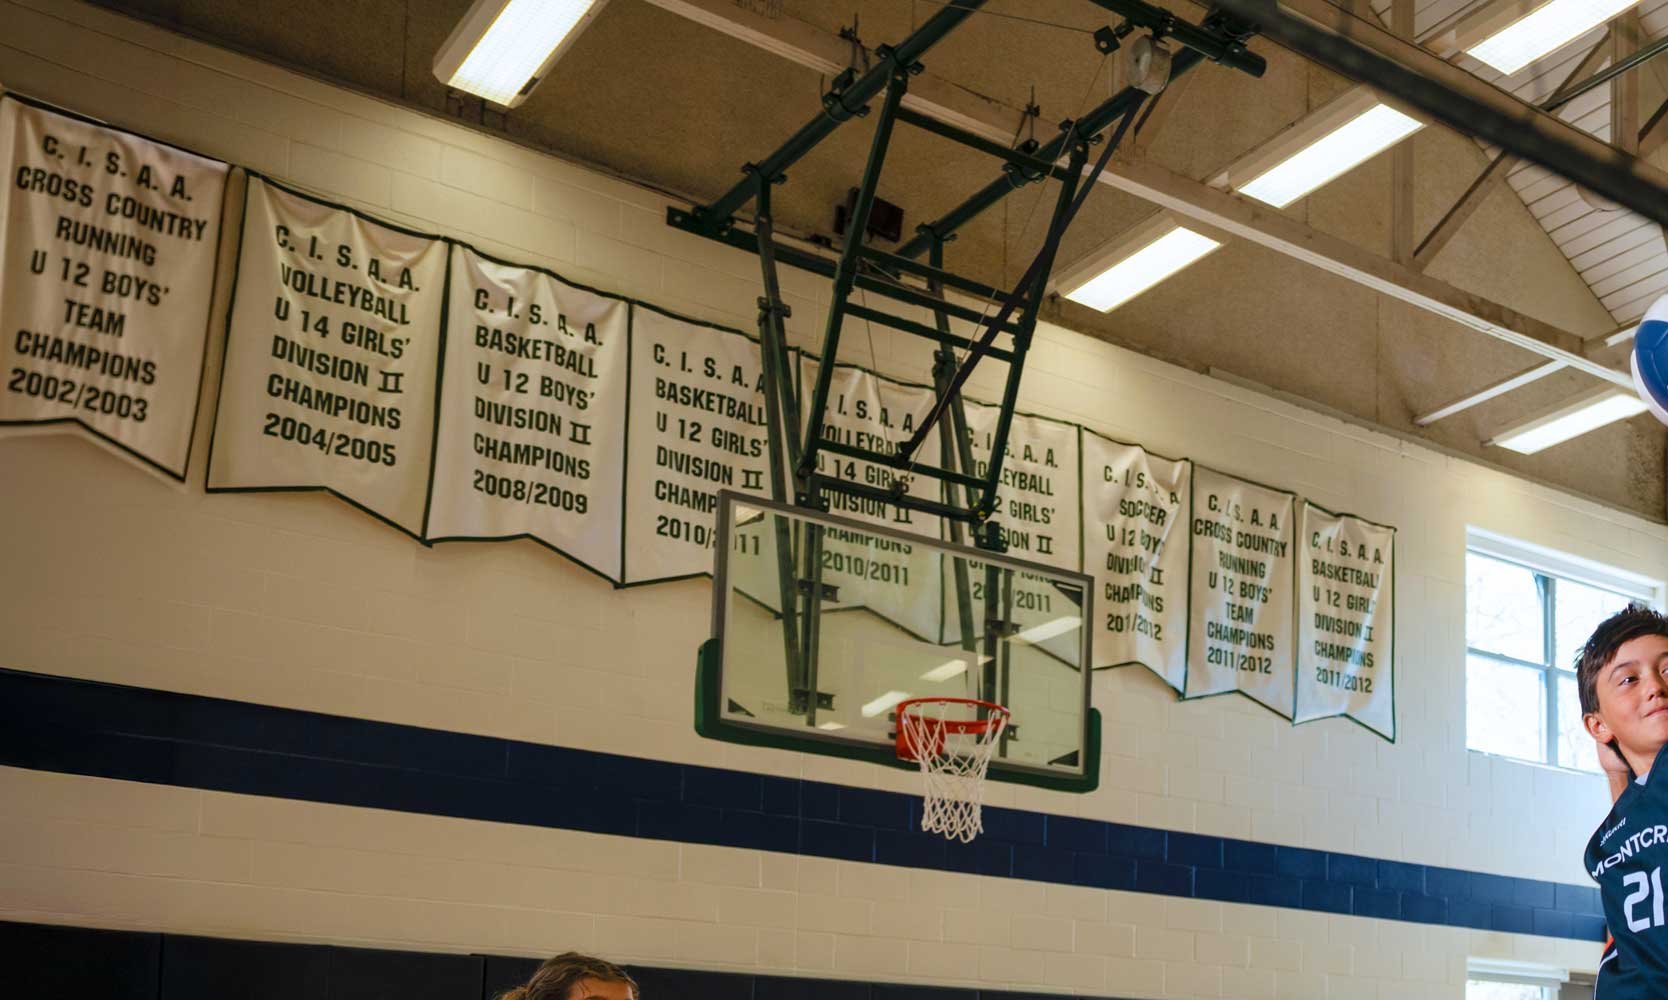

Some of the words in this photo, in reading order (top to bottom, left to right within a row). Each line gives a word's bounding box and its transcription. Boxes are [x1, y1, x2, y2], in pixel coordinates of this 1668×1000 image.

[16, 166, 93, 207] CROSS
[106, 193, 207, 242] COUNTRY
[57, 217, 156, 266] RUNNING
[31, 250, 46, 275] U
[61, 257, 88, 287] 12
[102, 271, 170, 307] BOYS'
[282, 263, 410, 325] VOLLEYBALL
[64, 300, 125, 338] TEAM
[275, 298, 289, 322] U
[301, 310, 329, 339] 14
[342, 320, 411, 359] GIRLS'
[15, 329, 157, 386] CHAMPIONS
[272, 335, 368, 387] DIVISION
[379, 369, 404, 394] II
[475, 325, 599, 379] BASKETBALL
[8, 368, 148, 423] 2002/2003
[267, 373, 402, 431] CHAMPIONS
[477, 362, 491, 384] U
[503, 369, 528, 394] 12
[540, 375, 595, 411] BOYS'
[656, 377, 768, 426] BASKETBALL
[756, 373, 766, 394] A
[264, 412, 397, 468] 2004/2005
[475, 396, 562, 436] DIVISION
[568, 421, 592, 445] II
[656, 411, 667, 432] U
[678, 418, 701, 443] 12
[711, 427, 768, 457] GIRLS'
[474, 433, 591, 480] CHAMPIONS
[656, 446, 733, 486] DIVISION
[741, 469, 763, 490] II
[834, 460, 856, 480] 14
[473, 469, 588, 514] 2008/2009
[655, 479, 718, 514] CHAMP
[1010, 500, 1055, 525] GIRLS'
[1120, 498, 1167, 527] SOCCER
[1036, 534, 1053, 555] II
[1106, 524, 1115, 541] U
[1122, 528, 1135, 546] 12
[1194, 518, 1232, 544] CROSS
[1236, 531, 1287, 558] COUNTRY
[822, 550, 908, 586] 2010/2011
[1219, 550, 1266, 579] RUNNING
[1209, 571, 1217, 589] U
[1223, 576, 1234, 595] 12
[1240, 581, 1272, 604] BOYS'
[1313, 585, 1320, 602] U
[1326, 589, 1340, 608] 12
[1226, 602, 1253, 624] TEAM
[1315, 613, 1362, 638] DIVISION
[1207, 621, 1274, 651] CHAMPIONS
[1315, 640, 1374, 668] CHAMPIONS
[1207, 646, 1272, 674] 2011/2012
[1316, 666, 1372, 693] 2011/2012
[1623, 866, 1665, 933] 21
